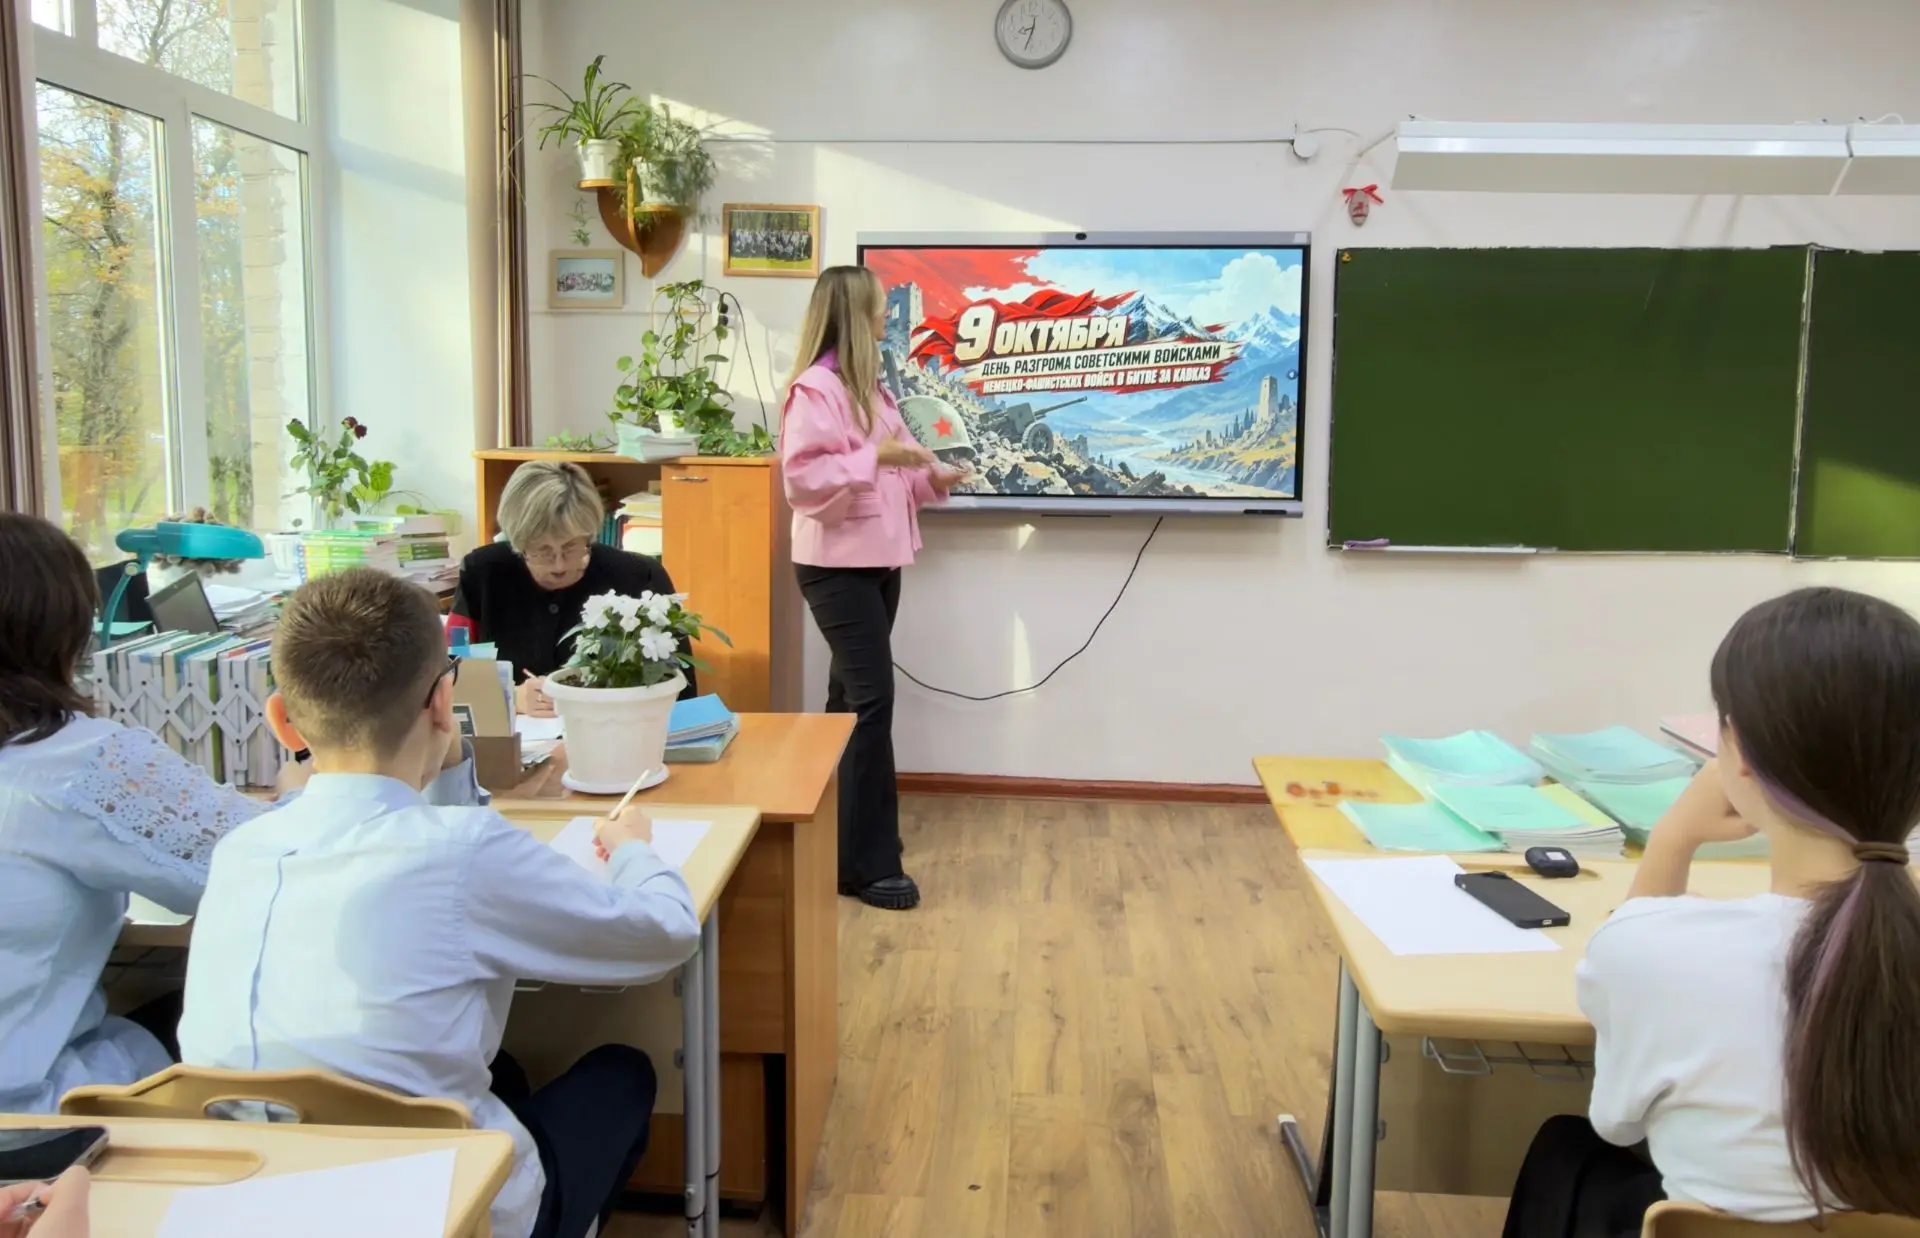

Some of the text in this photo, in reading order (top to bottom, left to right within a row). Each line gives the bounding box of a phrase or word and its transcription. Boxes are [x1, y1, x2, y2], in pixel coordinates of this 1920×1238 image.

[954, 305, 1127, 361] 9 ОКТЯБРЯ
[981, 344, 1221, 376] ДЕНЬ РАЗГРОМА СОВЕТСКИМИ ВОЙСКАМИ
[1084, 371, 1116, 387] ВОЙСК
[1126, 368, 1158, 384] БИТВЕ
[1159, 367, 1171, 382] ЗА
[1172, 366, 1212, 382] КАВКАЗ
